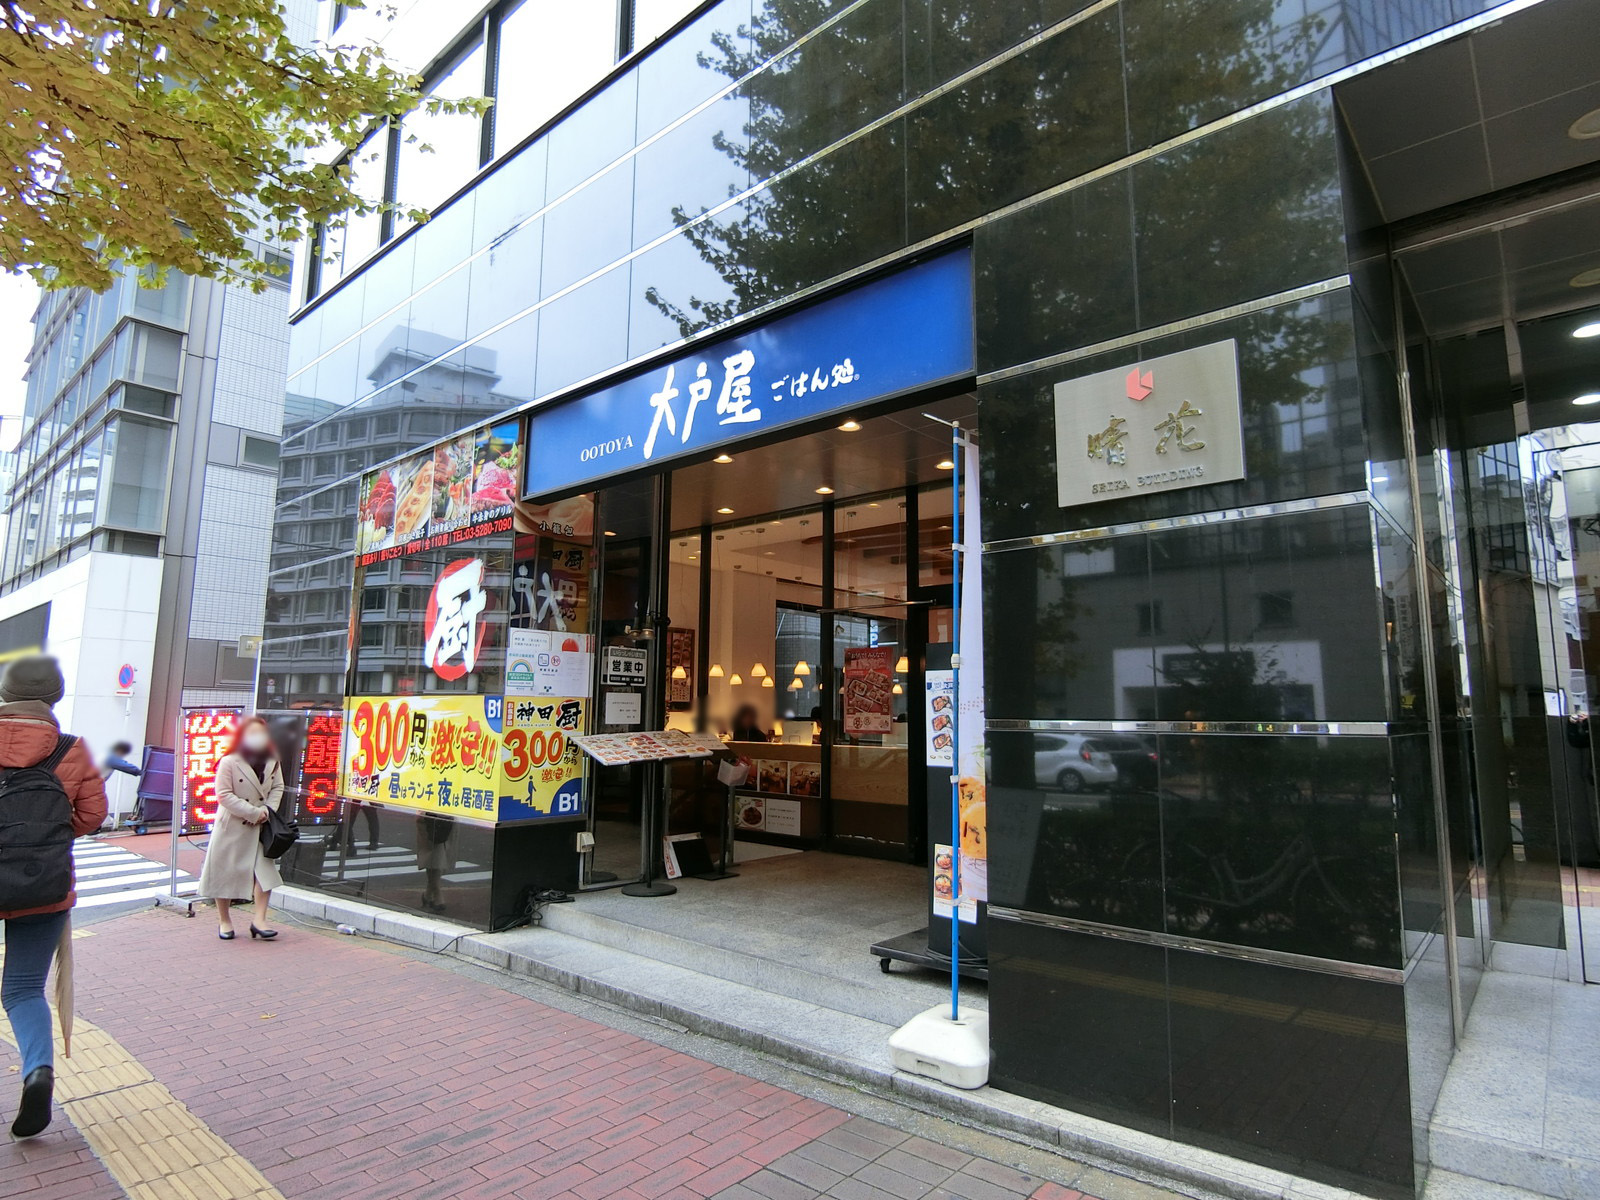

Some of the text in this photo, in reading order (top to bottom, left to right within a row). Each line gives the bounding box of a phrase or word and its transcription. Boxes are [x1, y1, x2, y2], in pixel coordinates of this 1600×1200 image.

[643, 349, 855, 459] 大戸屋 ごはん処
[580, 434, 634, 463] OOTOYA
[1091, 465, 1205, 494] SEIKA BUILDING
[453, 516, 512, 543] TEL:03-5280-7090
[539, 520, 575, 537] 小籠包
[612, 659, 644, 674] 営業中
[487, 699, 502, 719] B1
[516, 700, 583, 730] 神田厨
[388, 772, 434, 801] 昼はランチ
[438, 777, 495, 812] 夜は居酒屋
[558, 792, 579, 813] B1
